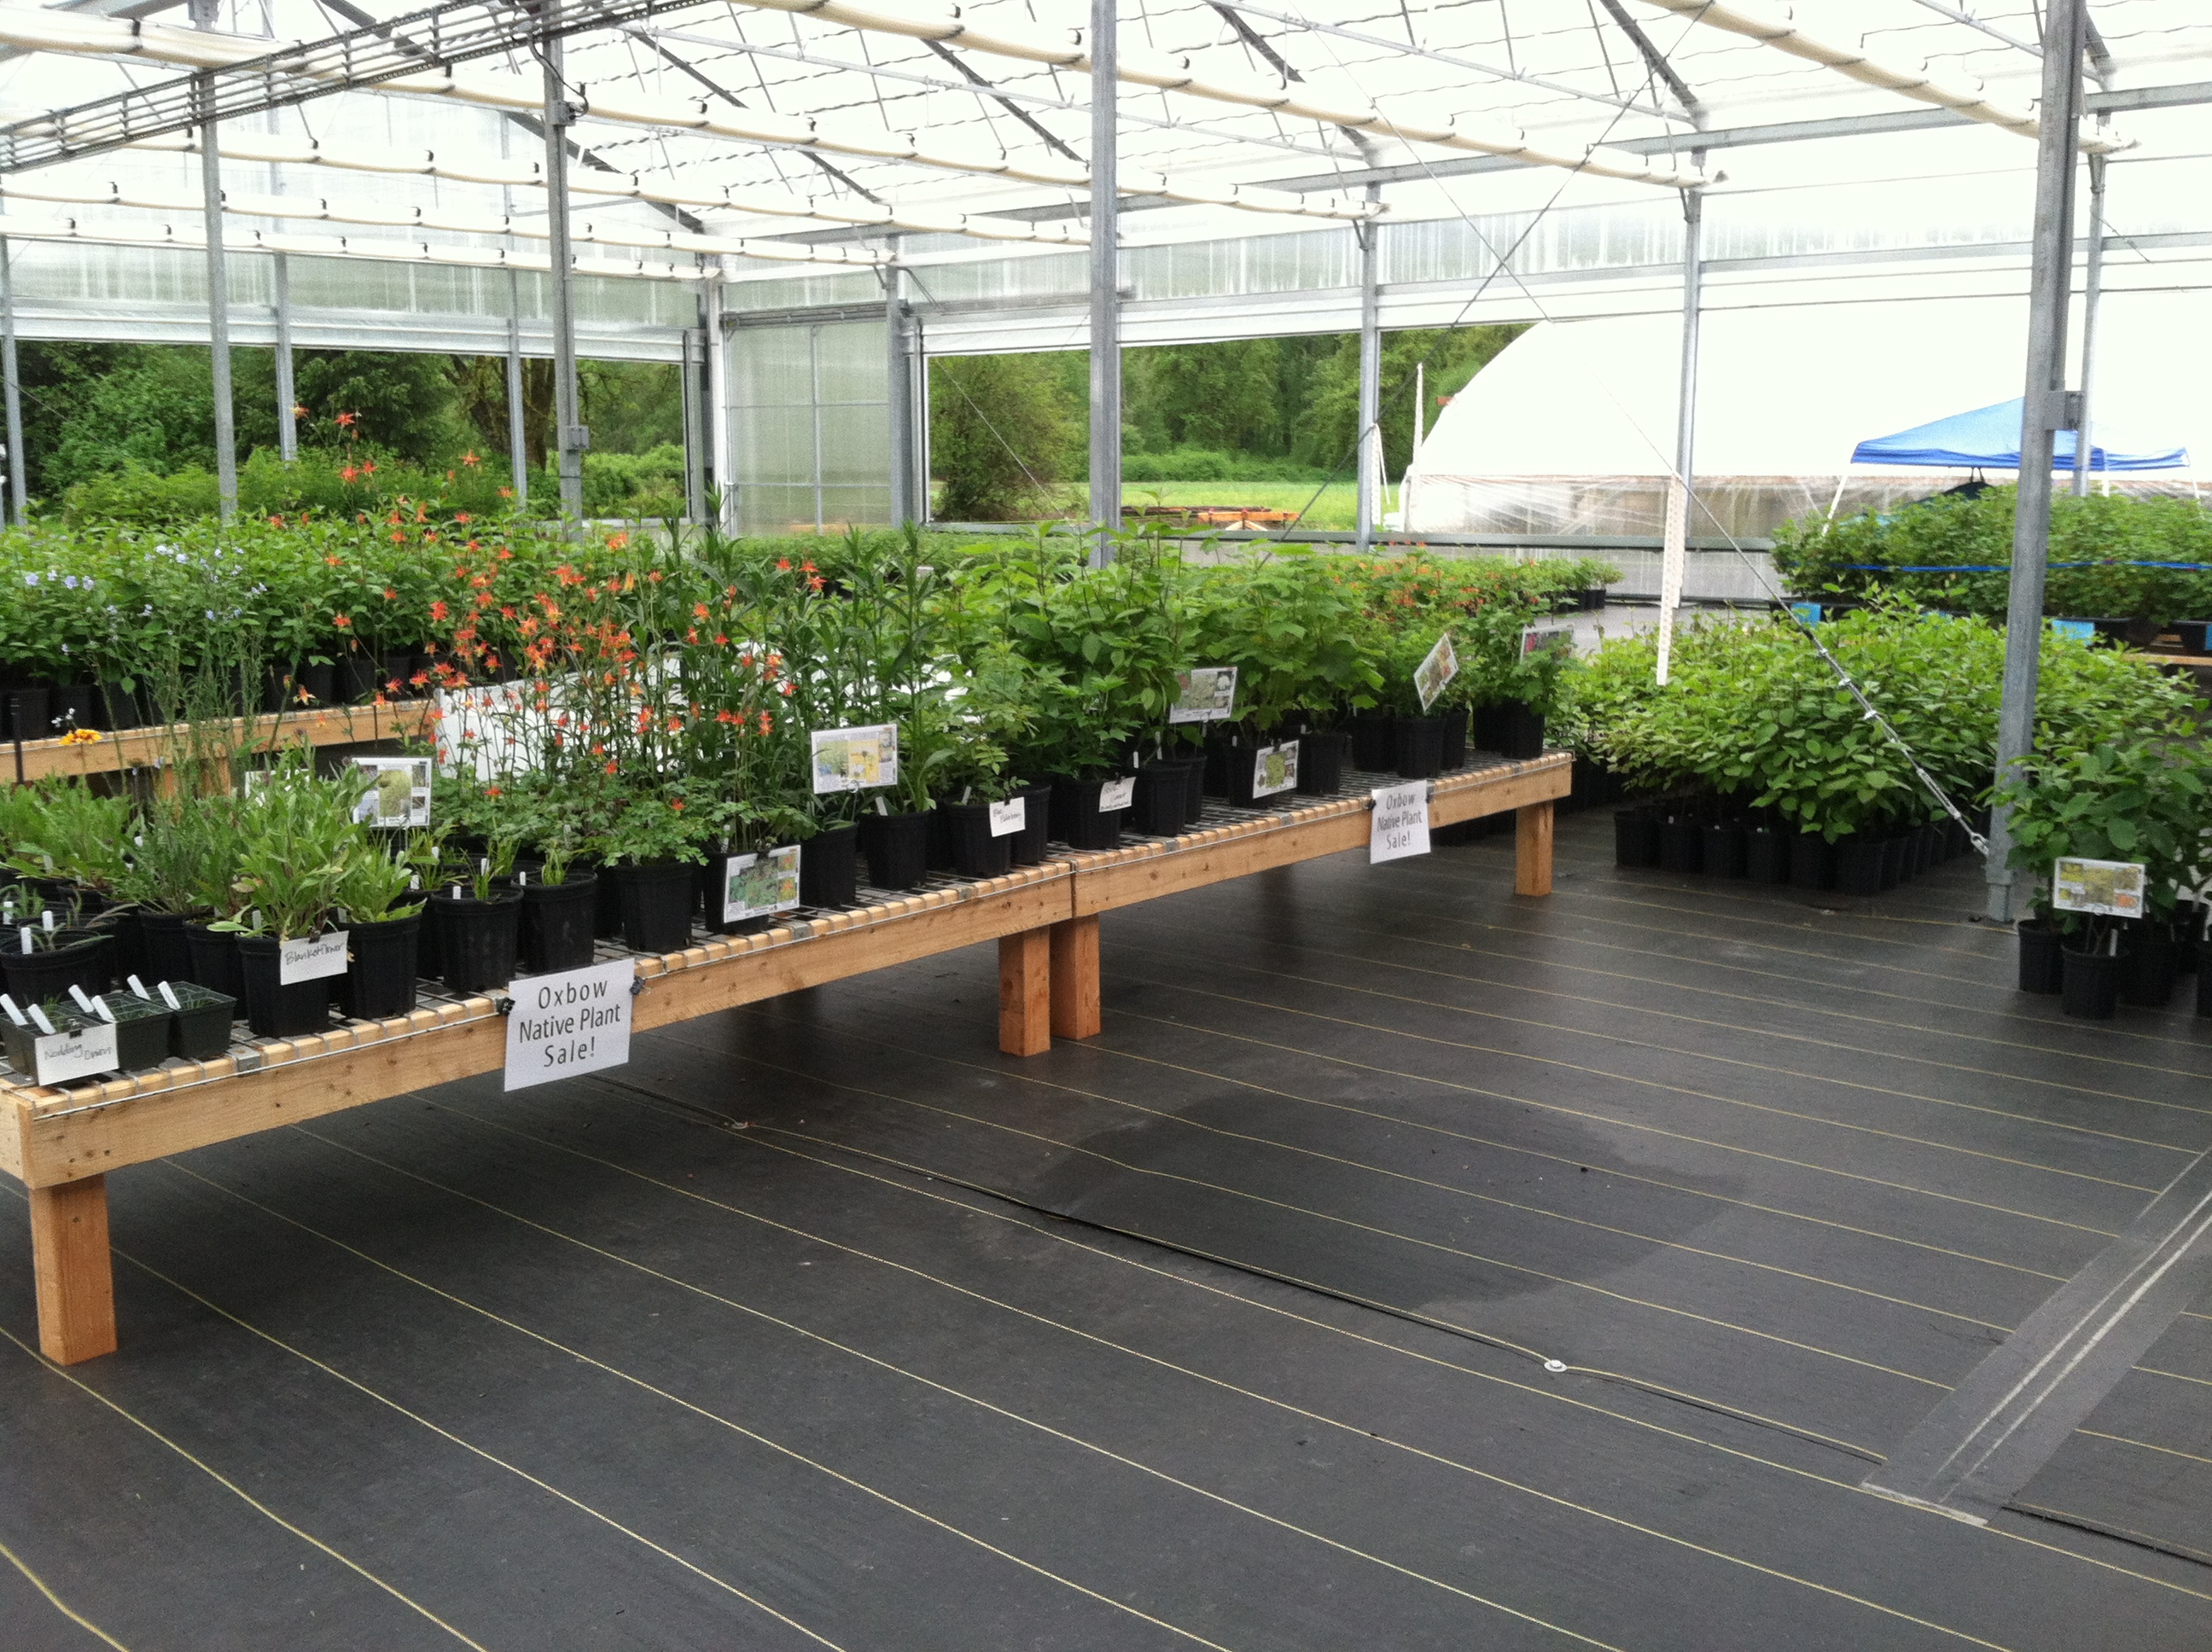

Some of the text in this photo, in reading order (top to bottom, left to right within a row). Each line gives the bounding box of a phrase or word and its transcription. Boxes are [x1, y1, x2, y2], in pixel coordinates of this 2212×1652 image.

[1386, 794, 1416, 810] Oxbow
[1377, 810, 1423, 831] Native Plant
[1386, 830, 1411, 850] Sale!
[538, 980, 608, 1009] Oxbow
[520, 1003, 620, 1043] Native Plant
[544, 1036, 596, 1067] Sale!
